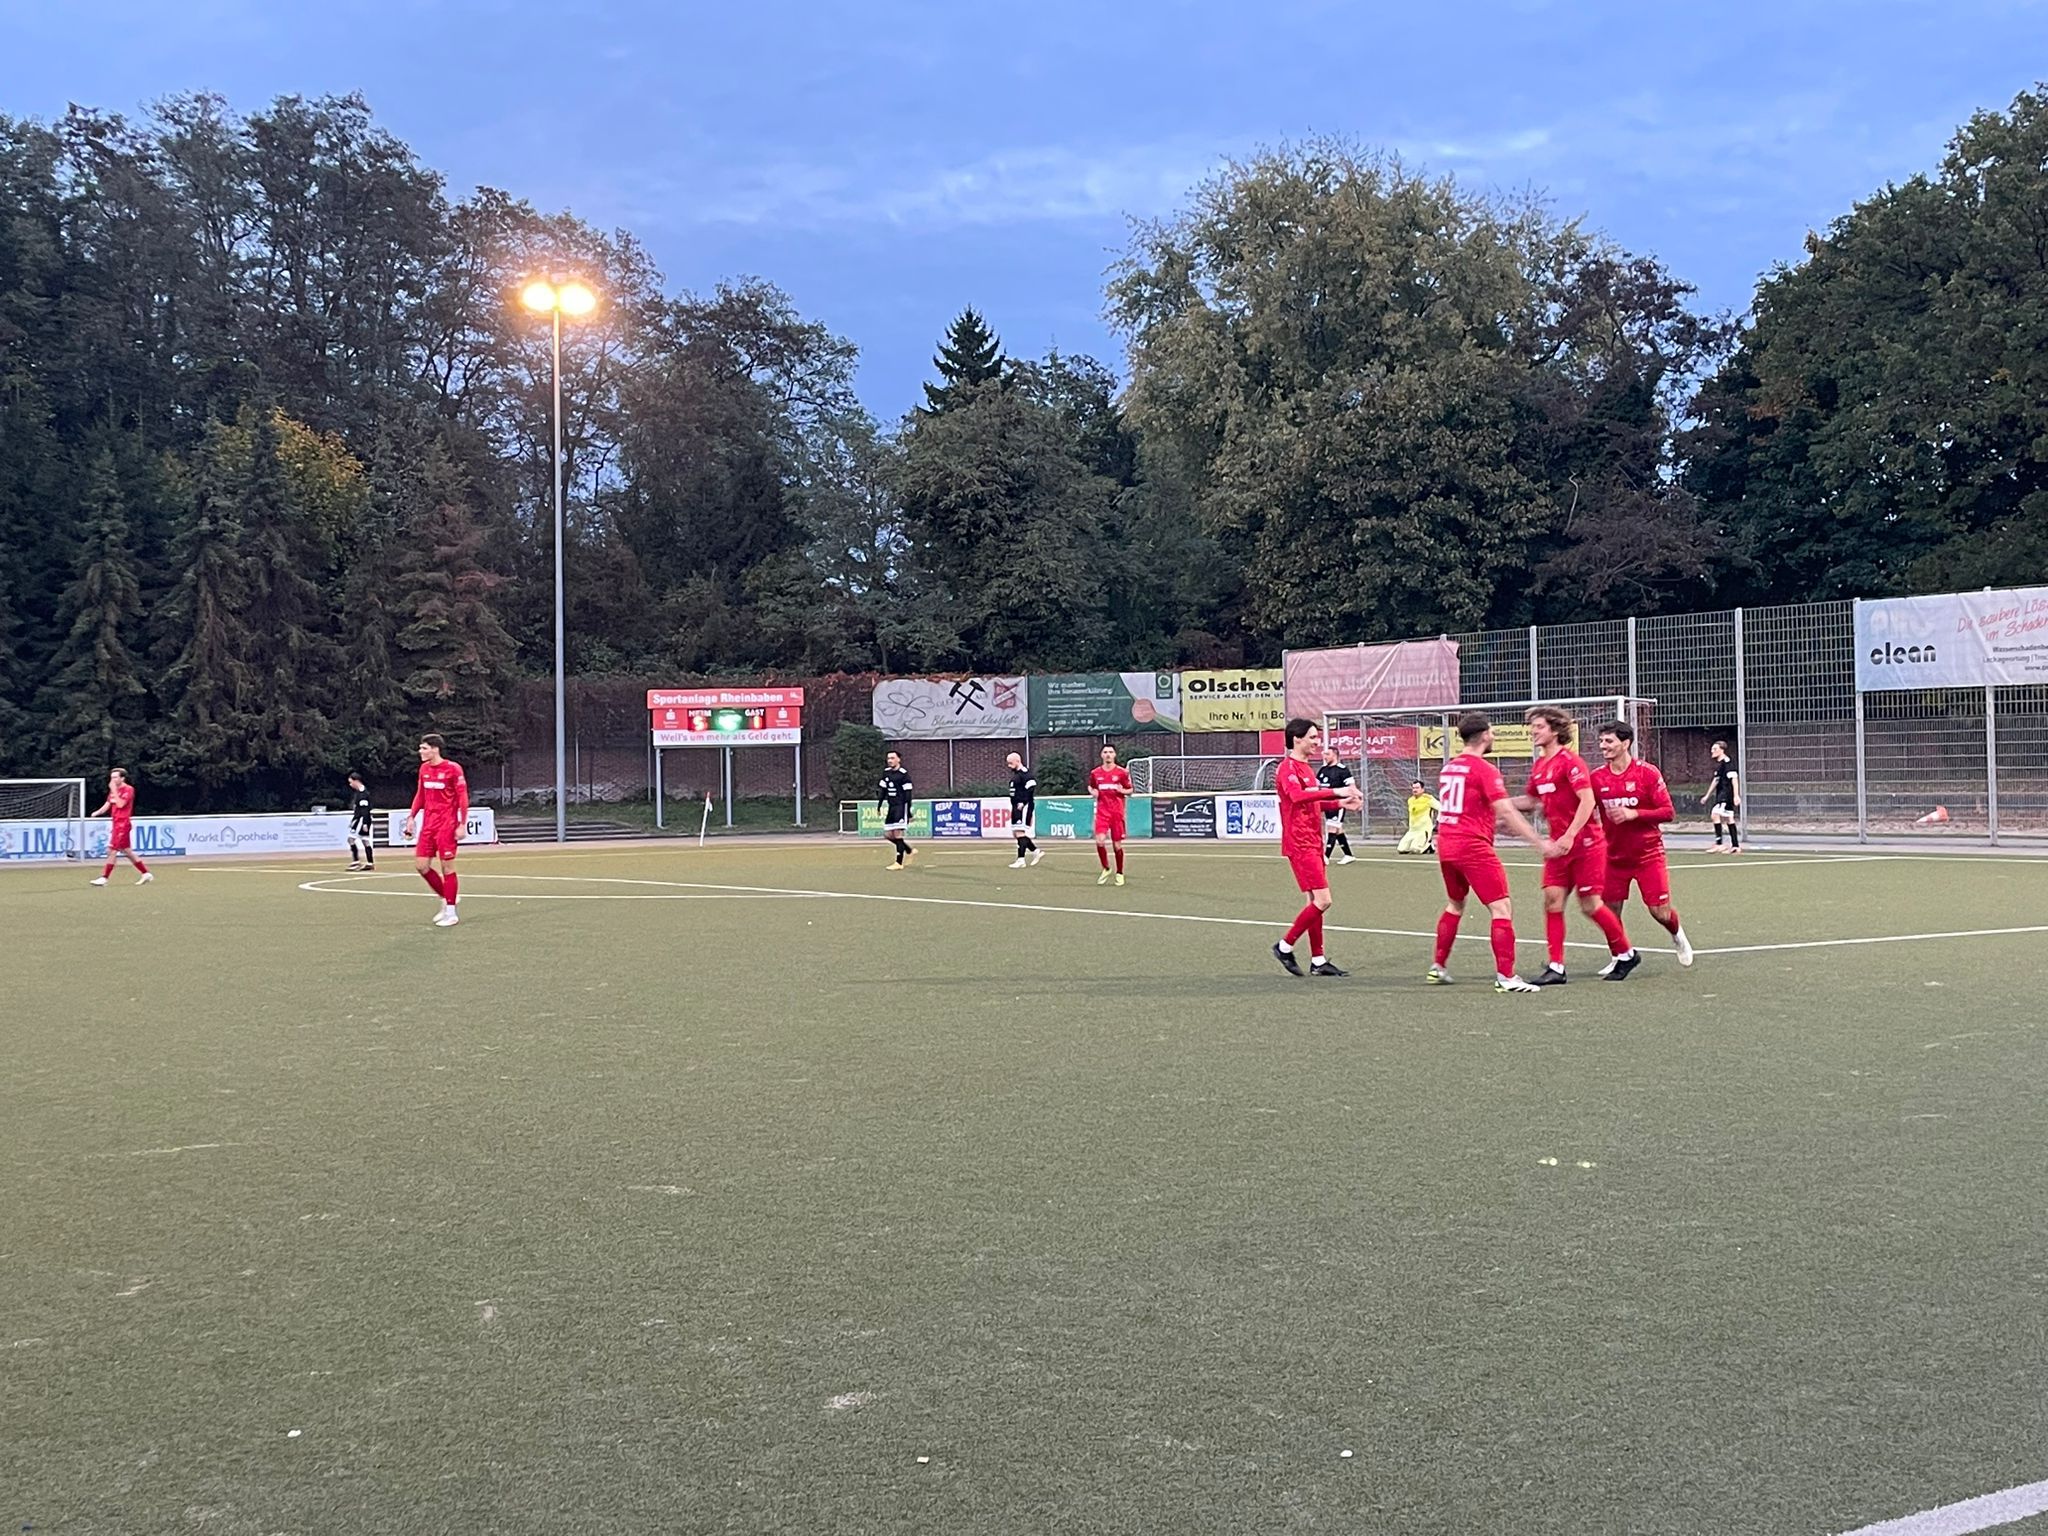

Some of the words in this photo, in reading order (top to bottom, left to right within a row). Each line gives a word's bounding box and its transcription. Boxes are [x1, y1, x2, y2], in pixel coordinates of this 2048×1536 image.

[1870, 642, 1936, 665] clean
[653, 693, 717, 705] Sportanlage
[720, 692, 783, 703] Rheinbaben
[744, 708, 765, 717] GAST
[1209, 711, 1229, 720] Ihre
[1232, 711, 1246, 720] Nr.
[1258, 710, 1268, 720] in
[707, 733, 730, 741] mehr
[733, 732, 746, 740] als
[748, 731, 769, 740] Geld
[1439, 775, 1466, 814] 20
[982, 809, 1012, 828] BEP
[1050, 824, 1075, 836] DEVK
[136, 826, 175, 851] MS
[188, 832, 219, 843] Markt
